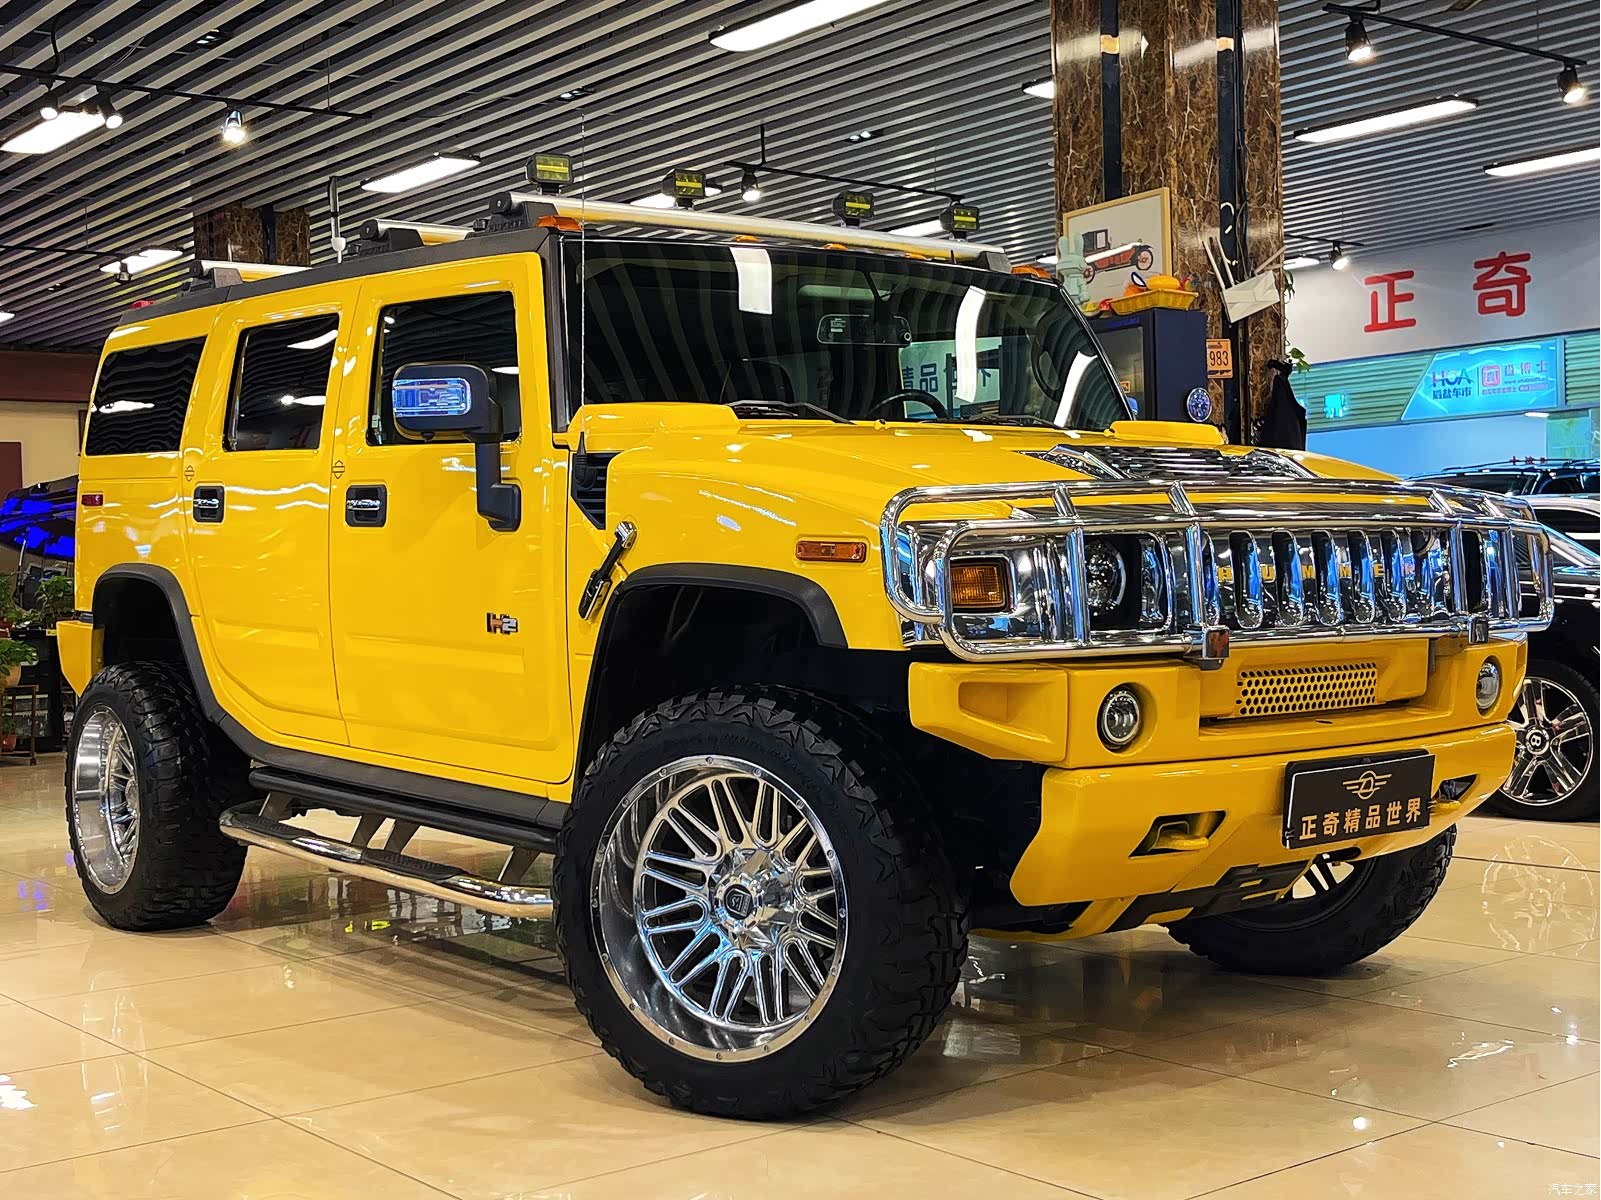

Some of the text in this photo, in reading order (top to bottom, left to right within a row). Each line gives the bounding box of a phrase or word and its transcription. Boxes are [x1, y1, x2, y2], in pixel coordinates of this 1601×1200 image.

[1364, 251, 1531, 333] 正奇
[1209, 350, 1229, 367] 983
[487, 612, 518, 636] H2
[1299, 796, 1421, 841] 正奇精品世界
